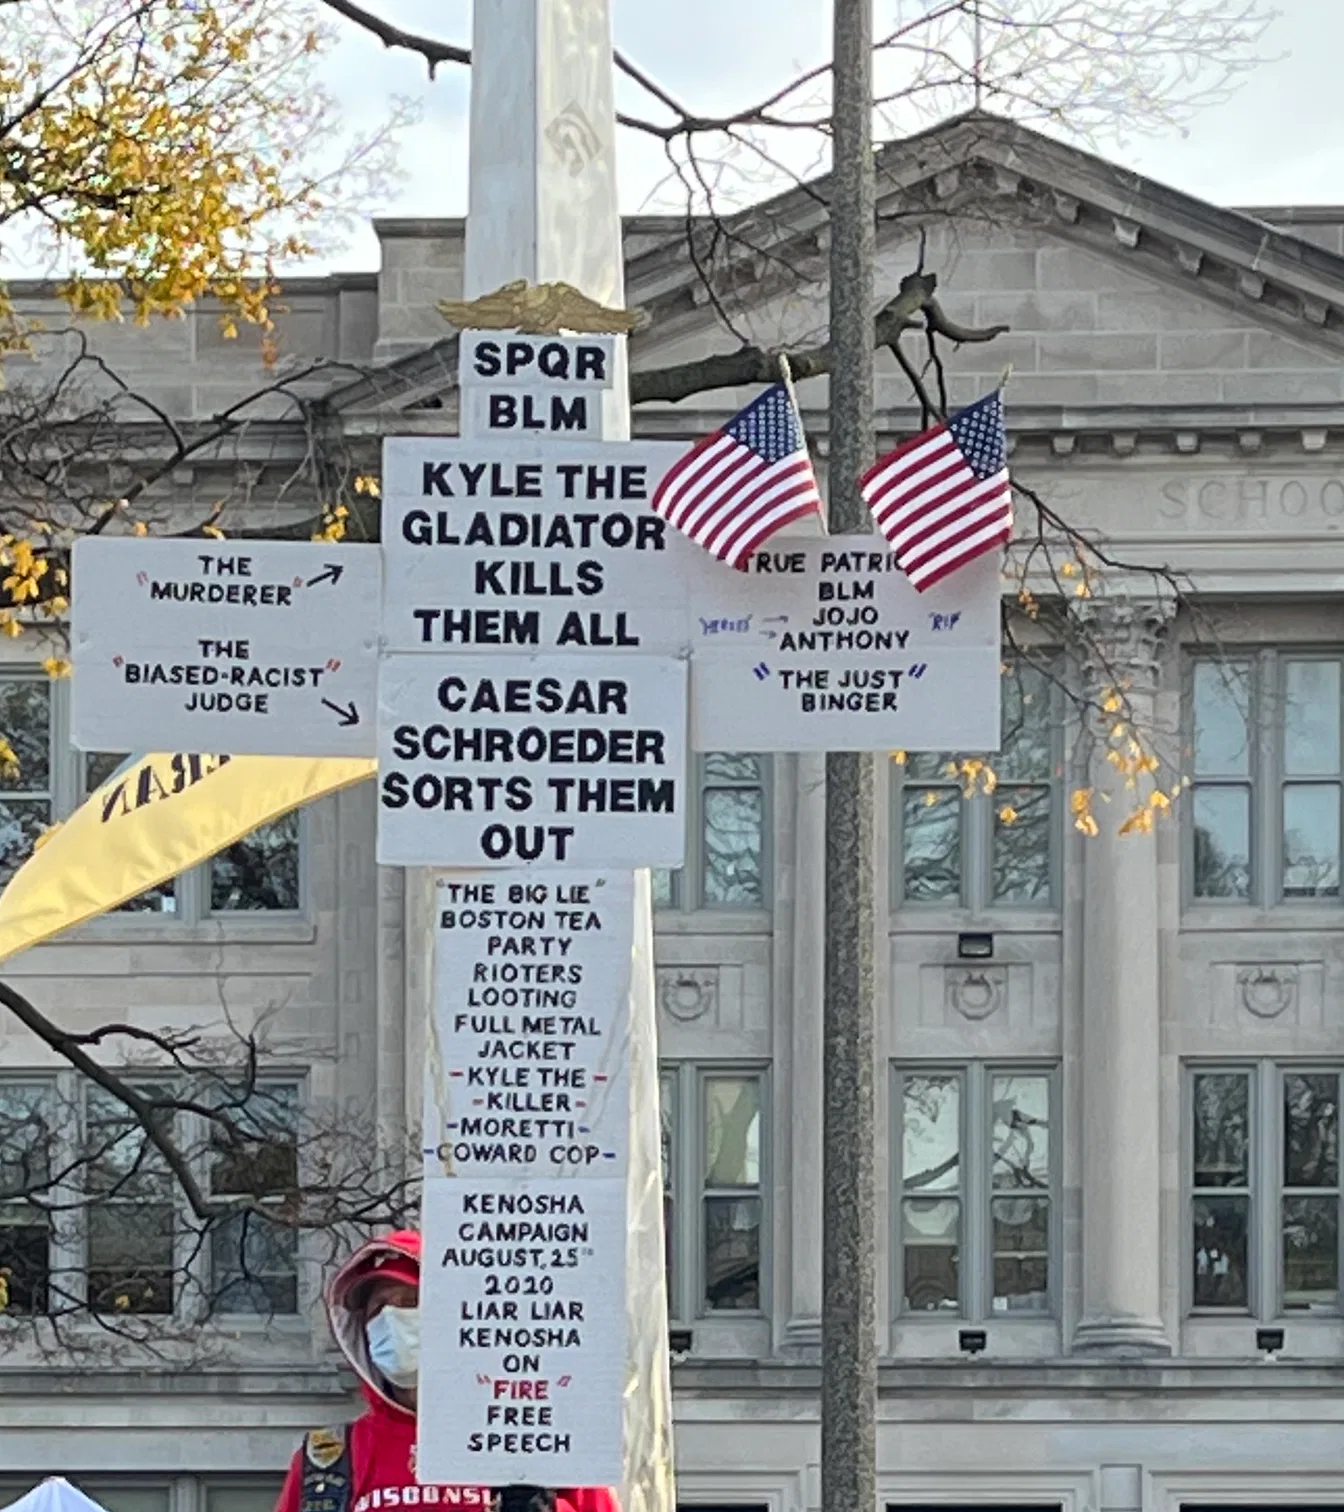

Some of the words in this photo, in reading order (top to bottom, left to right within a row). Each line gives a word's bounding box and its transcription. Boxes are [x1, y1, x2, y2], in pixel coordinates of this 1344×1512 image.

[474, 341, 606, 380] SPQR
[489, 394, 587, 431] BLM
[422, 461, 543, 498] KYLE
[557, 464, 648, 500] THE
[402, 509, 666, 551] GLADIATOR
[198, 555, 252, 576] THE
[474, 560, 604, 596] KILLS
[818, 580, 875, 602] BLM
[812, 606, 879, 627] JOJO
[413, 609, 540, 645] THEM
[556, 611, 640, 647] ALL
[198, 639, 250, 660] THE
[779, 630, 910, 652] ANTHONY
[184, 692, 270, 714] JUDGE
[437, 676, 628, 714] CAESAR
[801, 692, 899, 713] BINGER
[393, 724, 666, 765] SCHROEDER
[381, 771, 533, 812] SORTS
[548, 778, 675, 813] THEM
[480, 824, 575, 861] OUT
[508, 884, 548, 905] BIG
[440, 909, 545, 929] BOSTON
[554, 911, 602, 930] TEA
[487, 936, 572, 956] PARTY
[473, 962, 583, 984] RIOTERS
[467, 987, 577, 1008] LOOTING
[454, 1014, 516, 1034] FULL
[520, 1015, 602, 1036] METAL
[478, 1040, 577, 1060] JACKET
[462, 1194, 586, 1216] KENOSHA
[458, 1222, 589, 1243] CAMPAIGN
[484, 1274, 555, 1296] 2020
[460, 1301, 519, 1321] LIAR
[531, 1301, 585, 1323] LIAR
[459, 1327, 582, 1348] KENOSHA
[502, 1354, 541, 1374] ON
[486, 1405, 553, 1427] FREE
[467, 1433, 572, 1454] SPEECH
